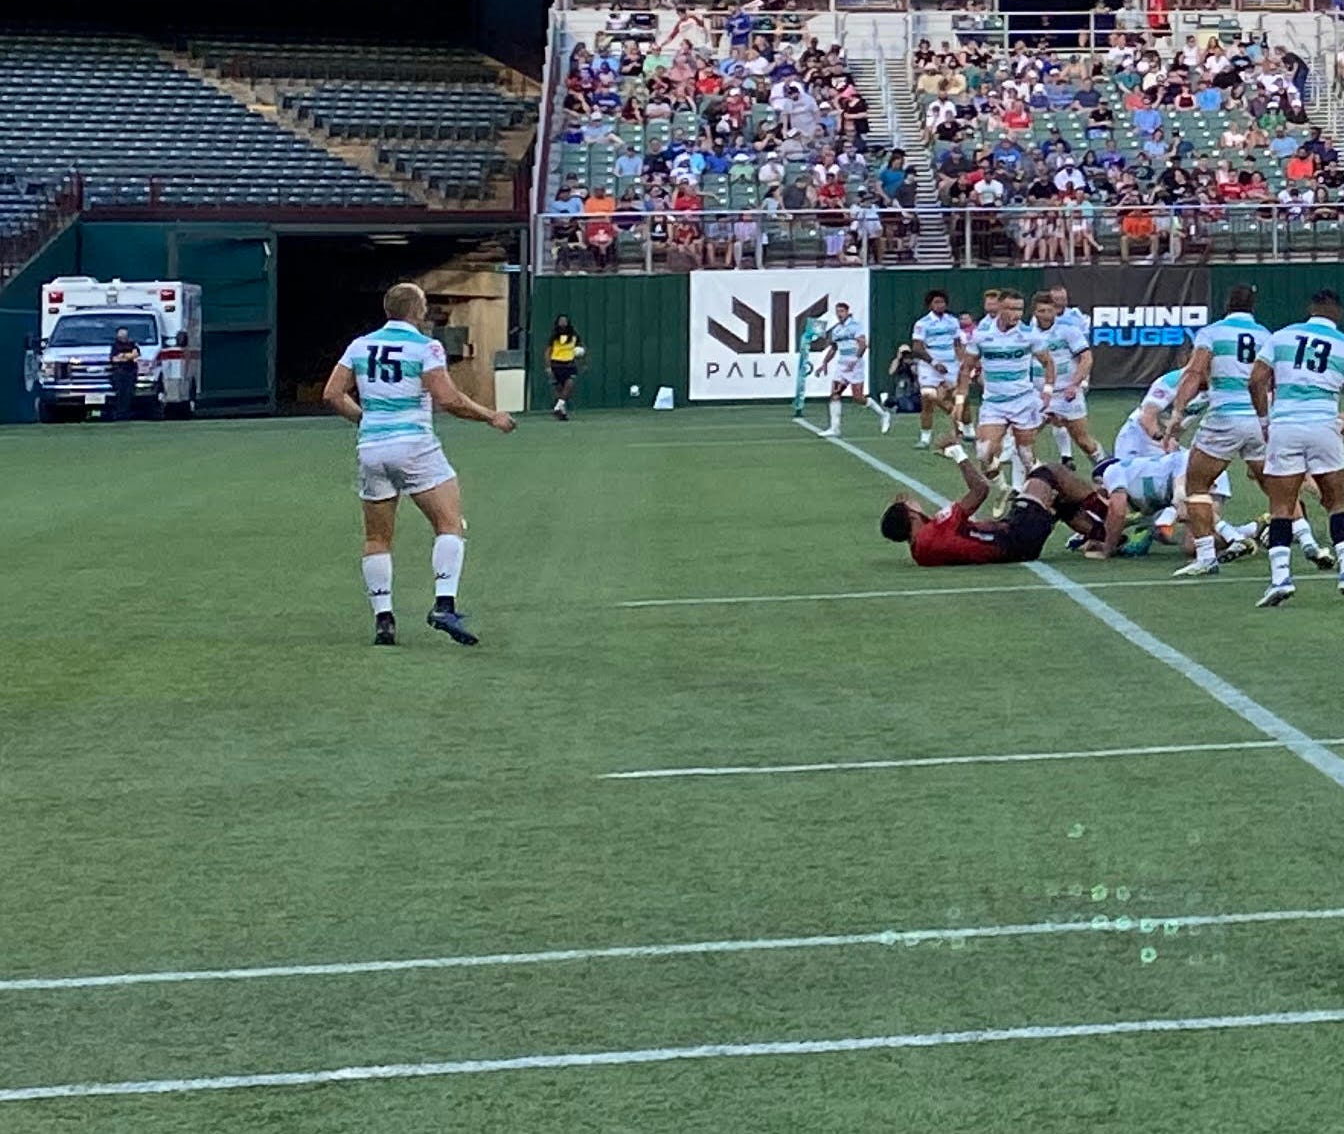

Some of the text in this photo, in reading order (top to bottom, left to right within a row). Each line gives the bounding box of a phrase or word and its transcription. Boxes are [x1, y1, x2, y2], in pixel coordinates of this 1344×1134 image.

[1093, 306, 1208, 327] RHINO
[366, 345, 404, 384] 15
[1237, 332, 1256, 365] 8
[1292, 334, 1332, 374] 13
[706, 360, 814, 379] PALAD
